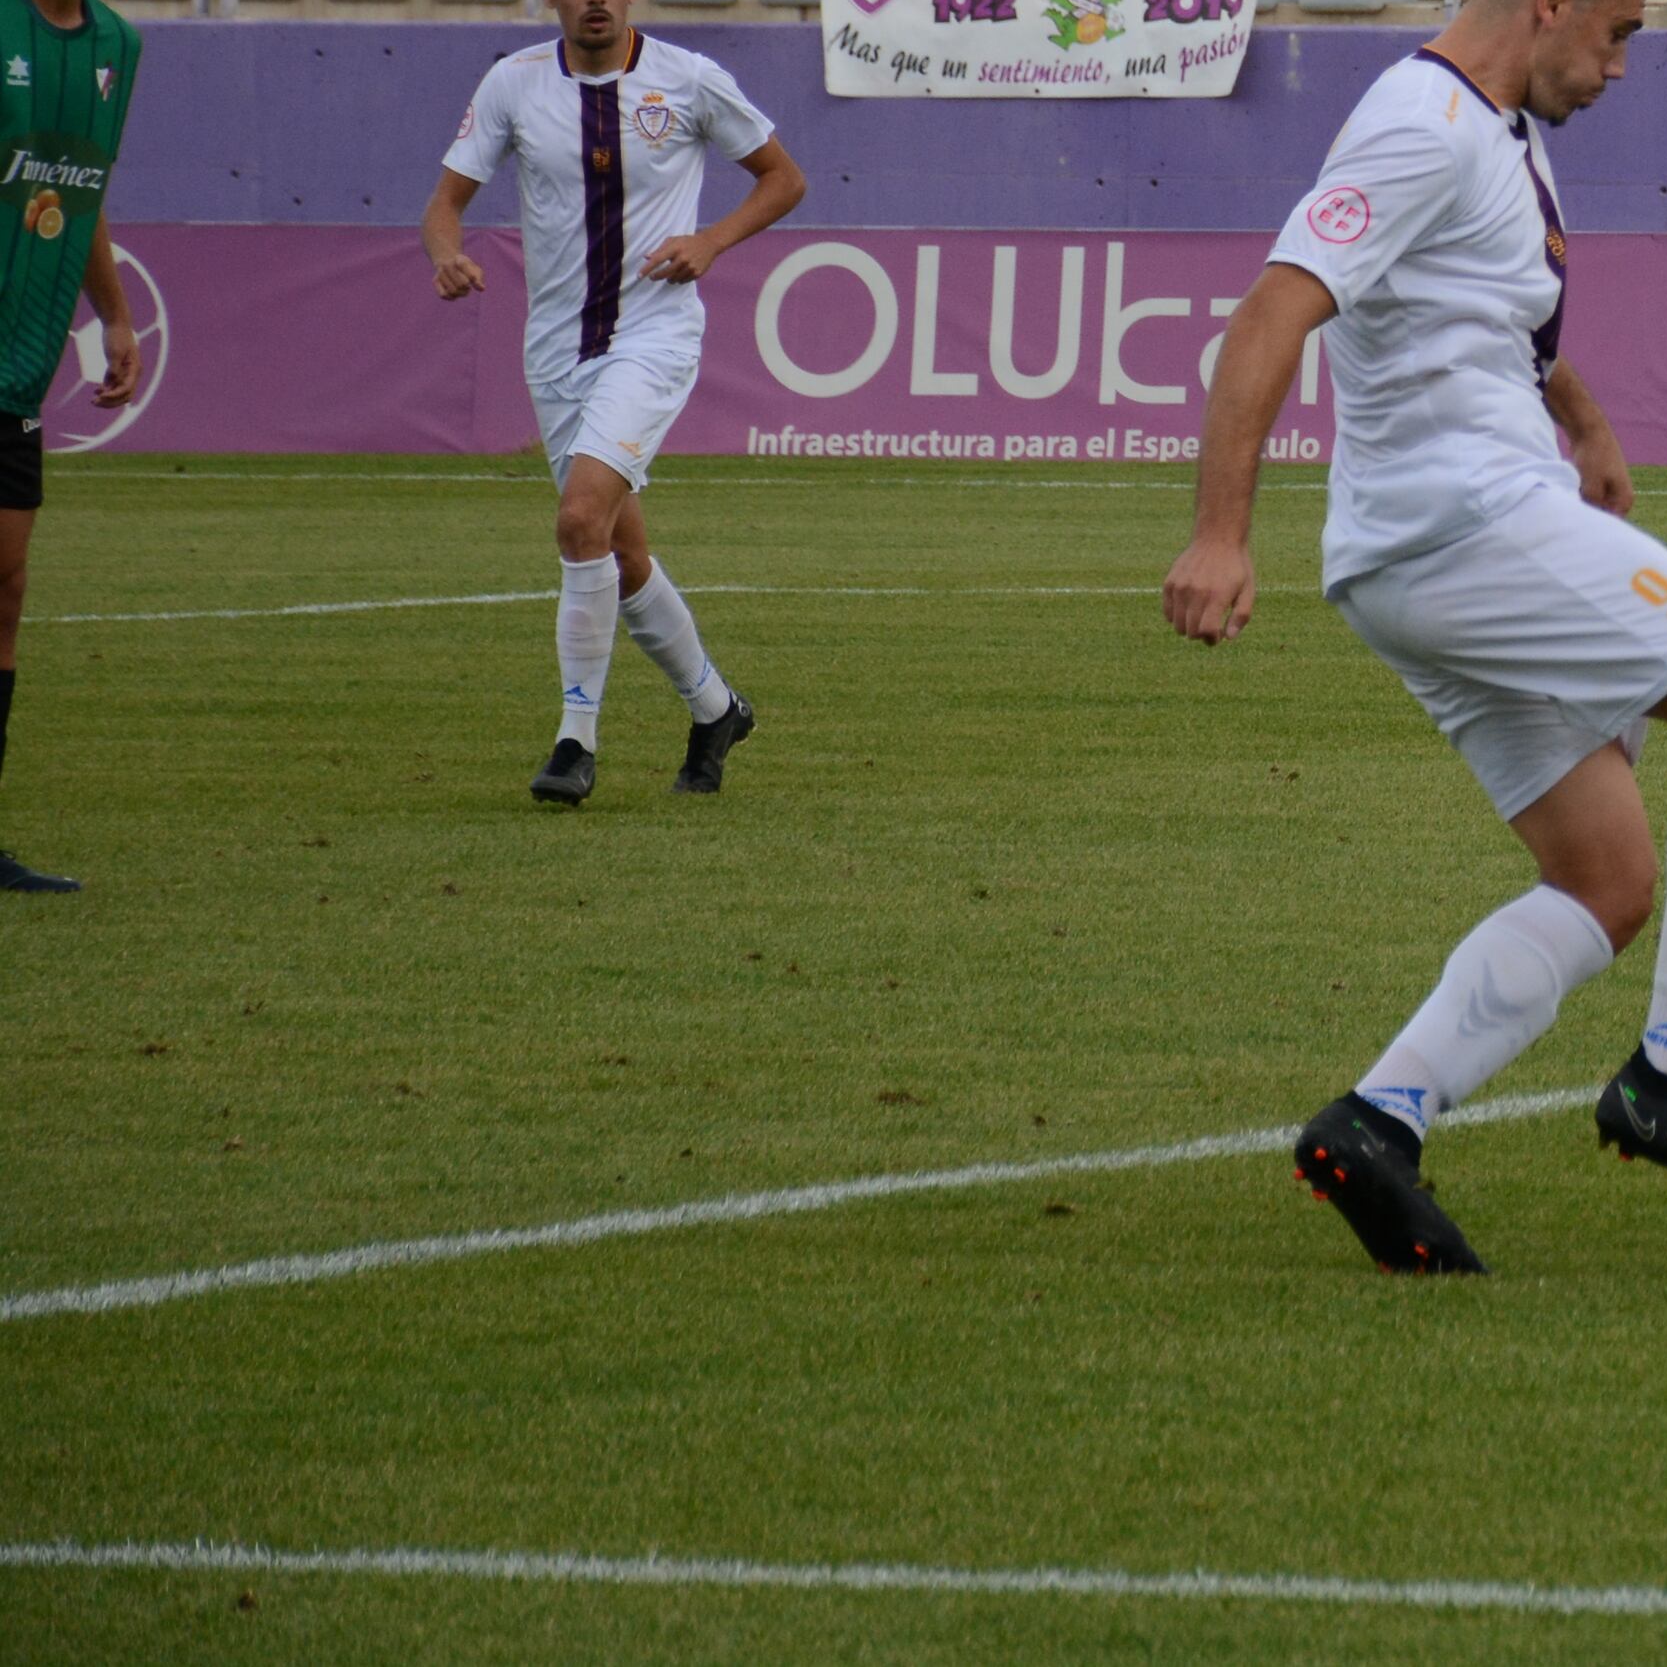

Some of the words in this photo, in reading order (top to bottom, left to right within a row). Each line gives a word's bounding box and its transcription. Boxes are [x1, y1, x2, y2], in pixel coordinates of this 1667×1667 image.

[826, 21, 881, 65] Mas
[890, 50, 931, 83] que
[941, 58, 968, 80] un
[977, 57, 1111, 85] sentimiento,
[1124, 53, 1167, 78] una
[2, 148, 105, 191] Jiménez
[747, 425, 996, 458] Infraestructura
[1004, 435, 1082, 461] para
[1086, 427, 1115, 458] el
[1124, 428, 1321, 461] Espeulo
